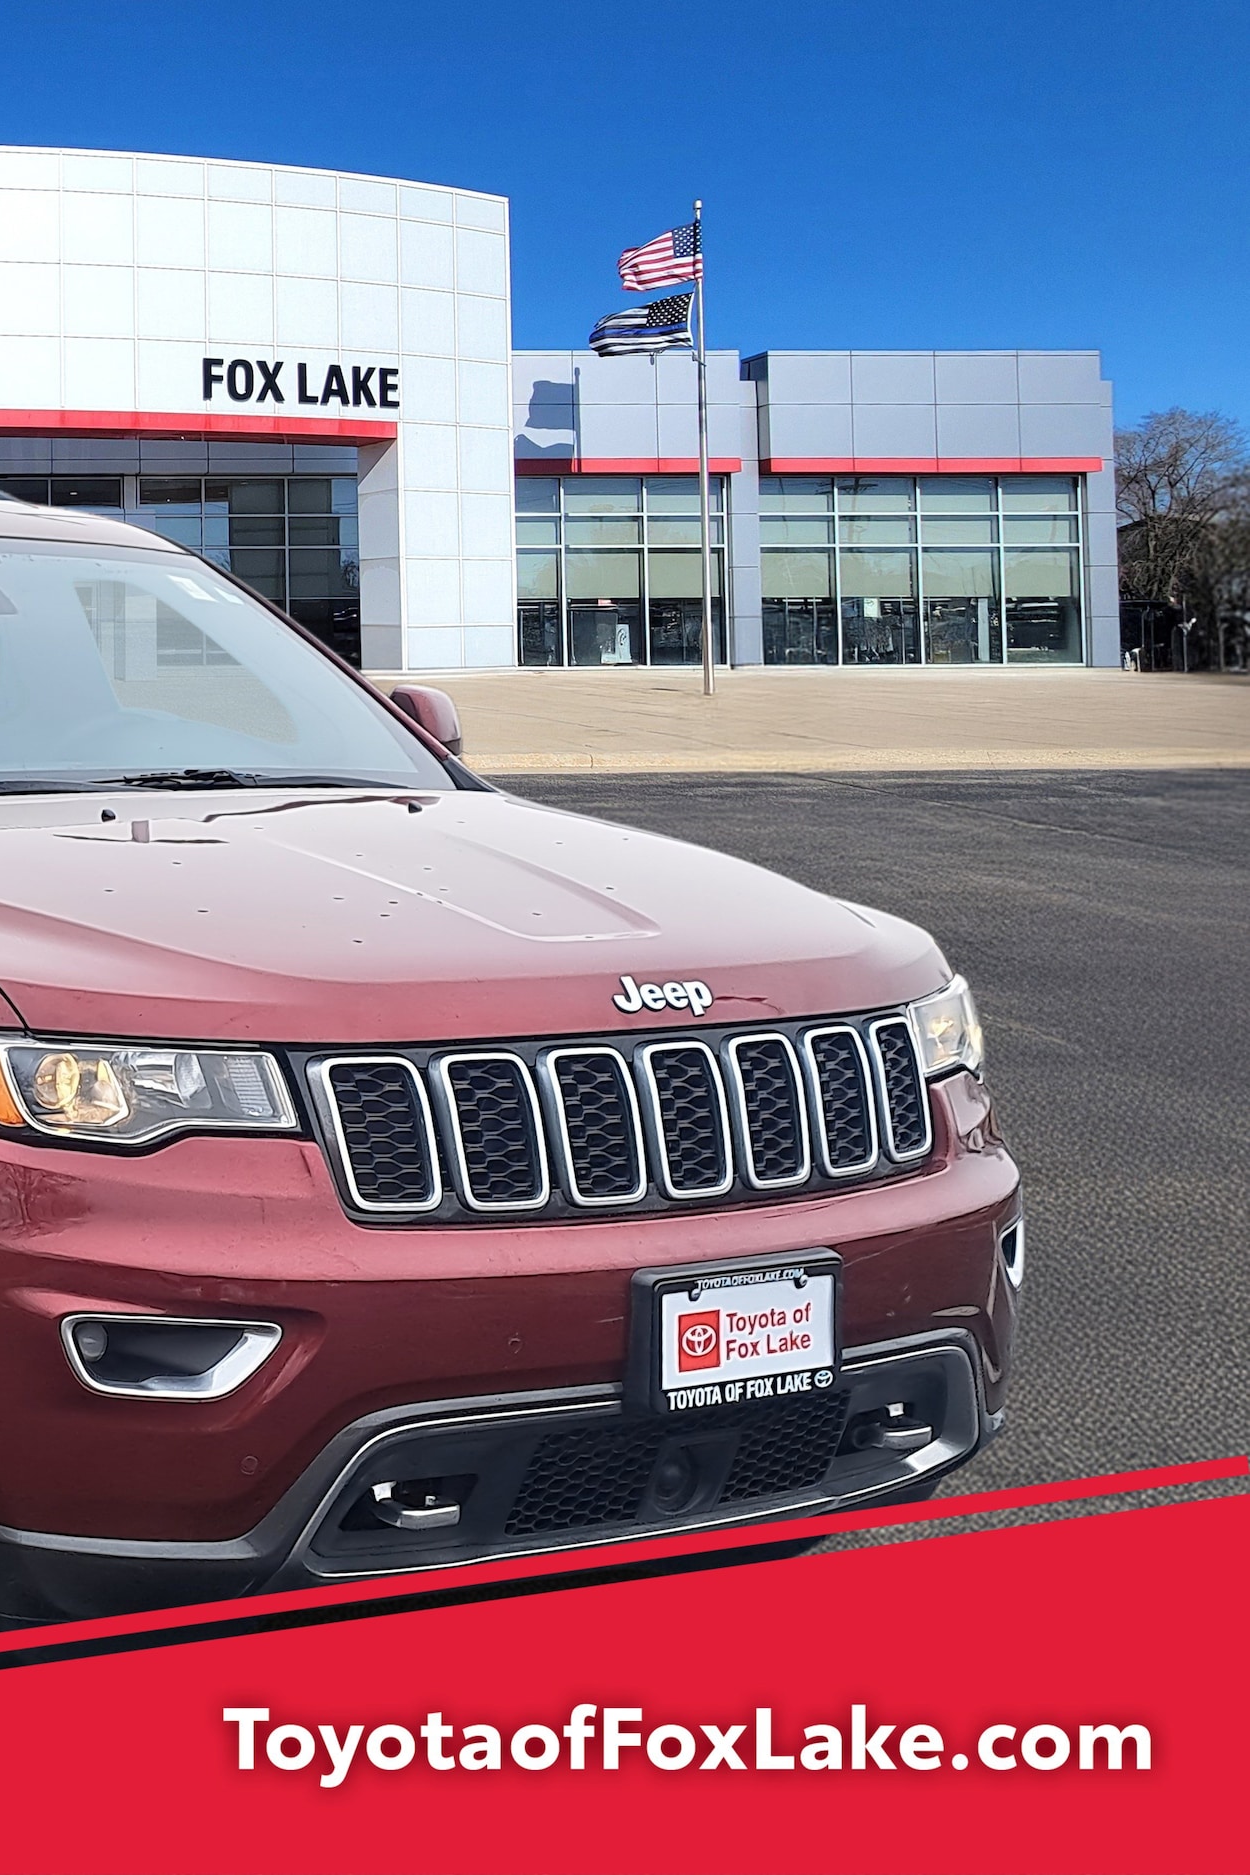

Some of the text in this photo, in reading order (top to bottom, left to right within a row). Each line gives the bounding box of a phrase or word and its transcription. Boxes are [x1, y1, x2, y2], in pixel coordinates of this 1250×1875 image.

[203, 357, 400, 408] FOX LAKE
[612, 975, 713, 1016] Jeep
[726, 1302, 812, 1335] Toyota of
[726, 1330, 811, 1360] Fox Lake
[667, 1372, 812, 1411] TOYOTA OF FOX LAKE
